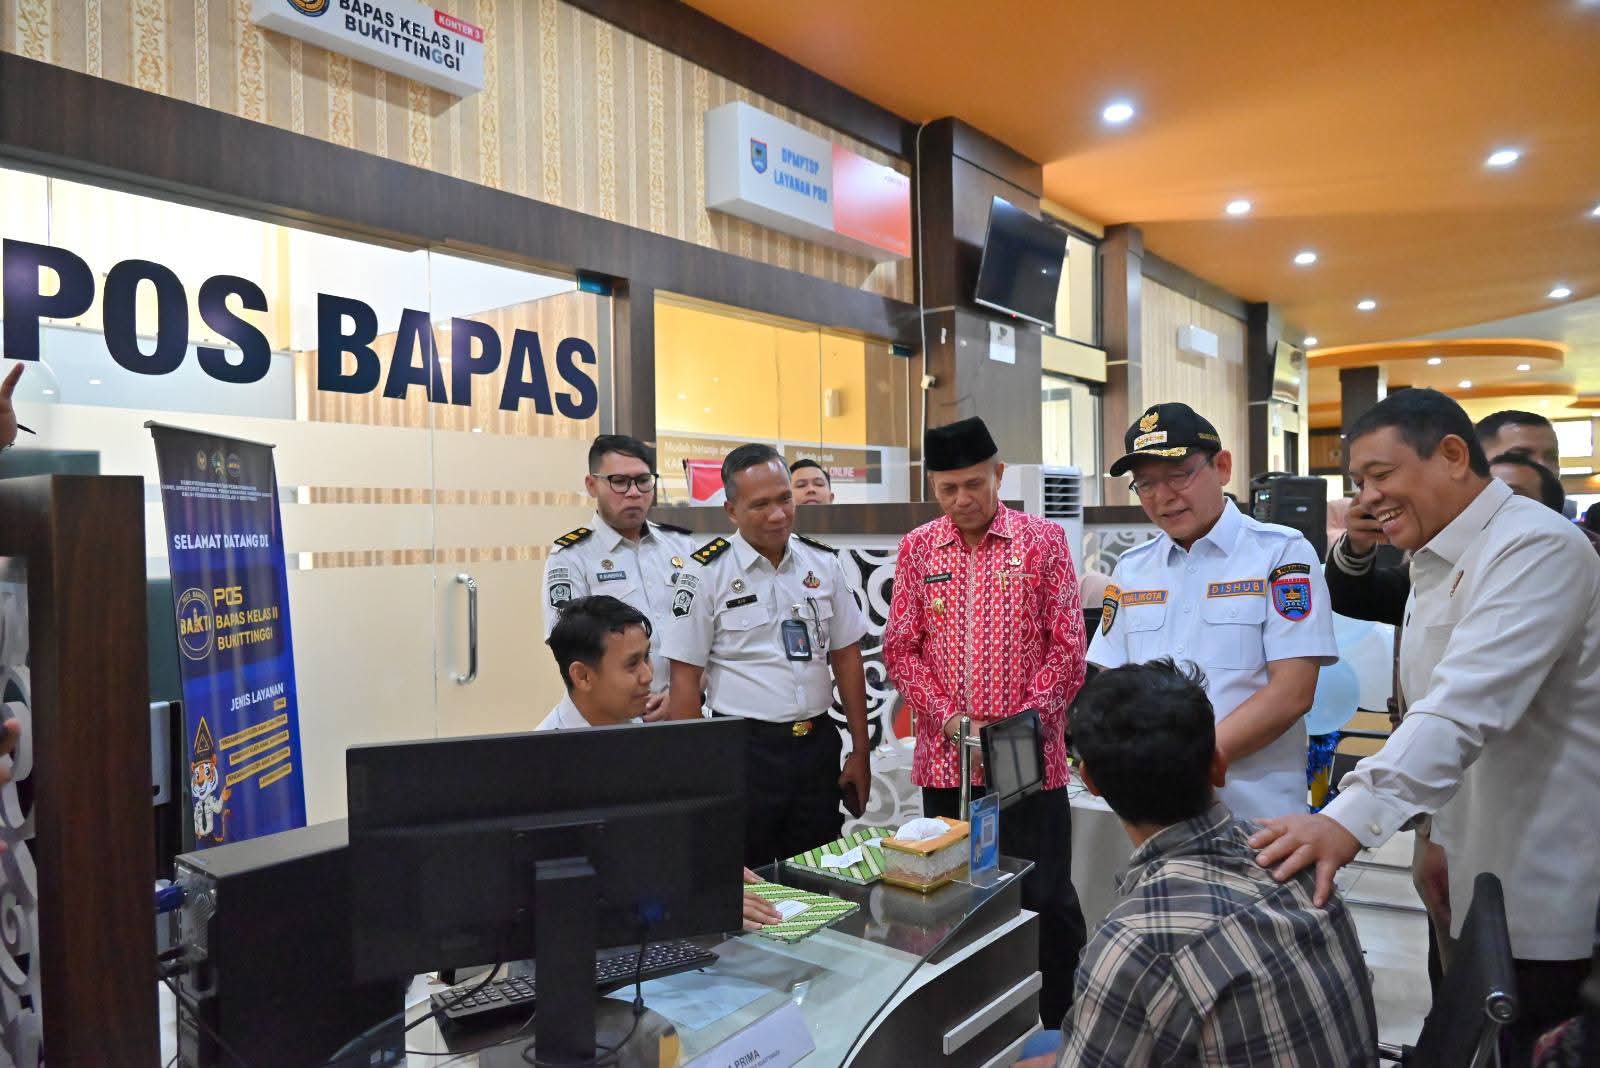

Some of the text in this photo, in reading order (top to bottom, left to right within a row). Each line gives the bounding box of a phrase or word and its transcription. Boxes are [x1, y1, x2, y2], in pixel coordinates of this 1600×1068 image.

[339, 0, 465, 56] BAPAS KELAS II
[438, 14, 474, 36] KONTER
[345, 14, 461, 72] BUKITTINGGI
[782, 147, 820, 175] DPMPTSP
[774, 169, 811, 197] LAYANAN
[2, 237, 599, 420] POS BAPAS
[829, 467, 855, 478] ONLINE
[174, 533, 269, 550] SELAMAT DATANG DI
[213, 585, 243, 608] POS
[1211, 581, 1260, 594] DISHUB
[215, 611, 246, 630] BAPAS
[247, 607, 272, 625] KELAS
[217, 630, 273, 651] BUKITTINGGI
[230, 693, 251, 712] JENIS
[251, 682, 284, 704] LAYANAN
[734, 1049, 760, 1068] PRIMA
